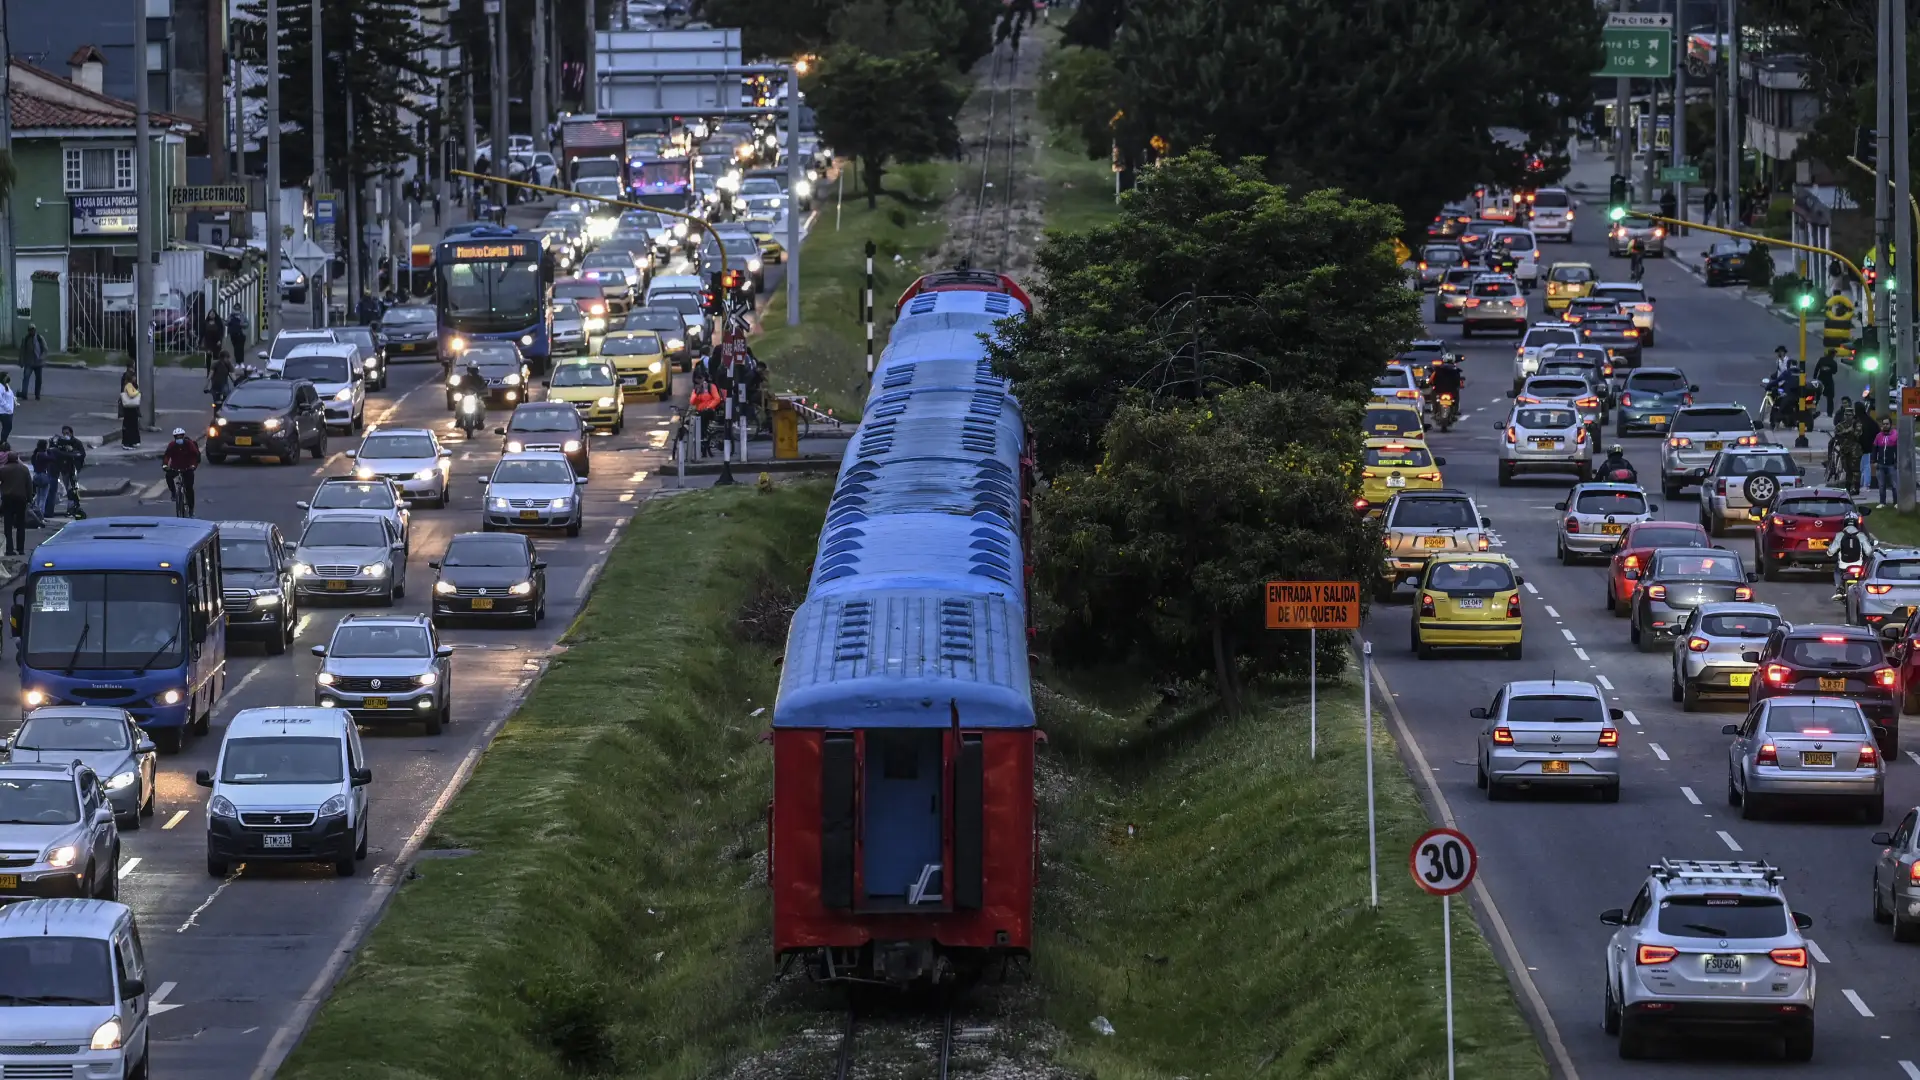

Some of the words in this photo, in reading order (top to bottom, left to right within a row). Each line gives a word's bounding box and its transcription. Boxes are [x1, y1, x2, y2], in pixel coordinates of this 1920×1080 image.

[1639, 16, 1654, 25] 106
[1627, 39, 1640, 49] 15
[1613, 55, 1635, 66] 106
[75, 197, 82, 208] LA
[82, 197, 96, 208] CASA
[96, 196, 104, 207] DE
[104, 196, 111, 207] LA
[111, 195, 138, 206] PORCELAN
[172, 186, 245, 205] FERRELECTRICOS
[1269, 585, 1312, 603] ENTRADA
[1314, 585, 1321, 603] Y
[1323, 585, 1357, 603] SALIDA
[1278, 605, 1291, 623] DE
[1292, 605, 1348, 623] VOLQUETAS
[1421, 840, 1465, 884] 30
